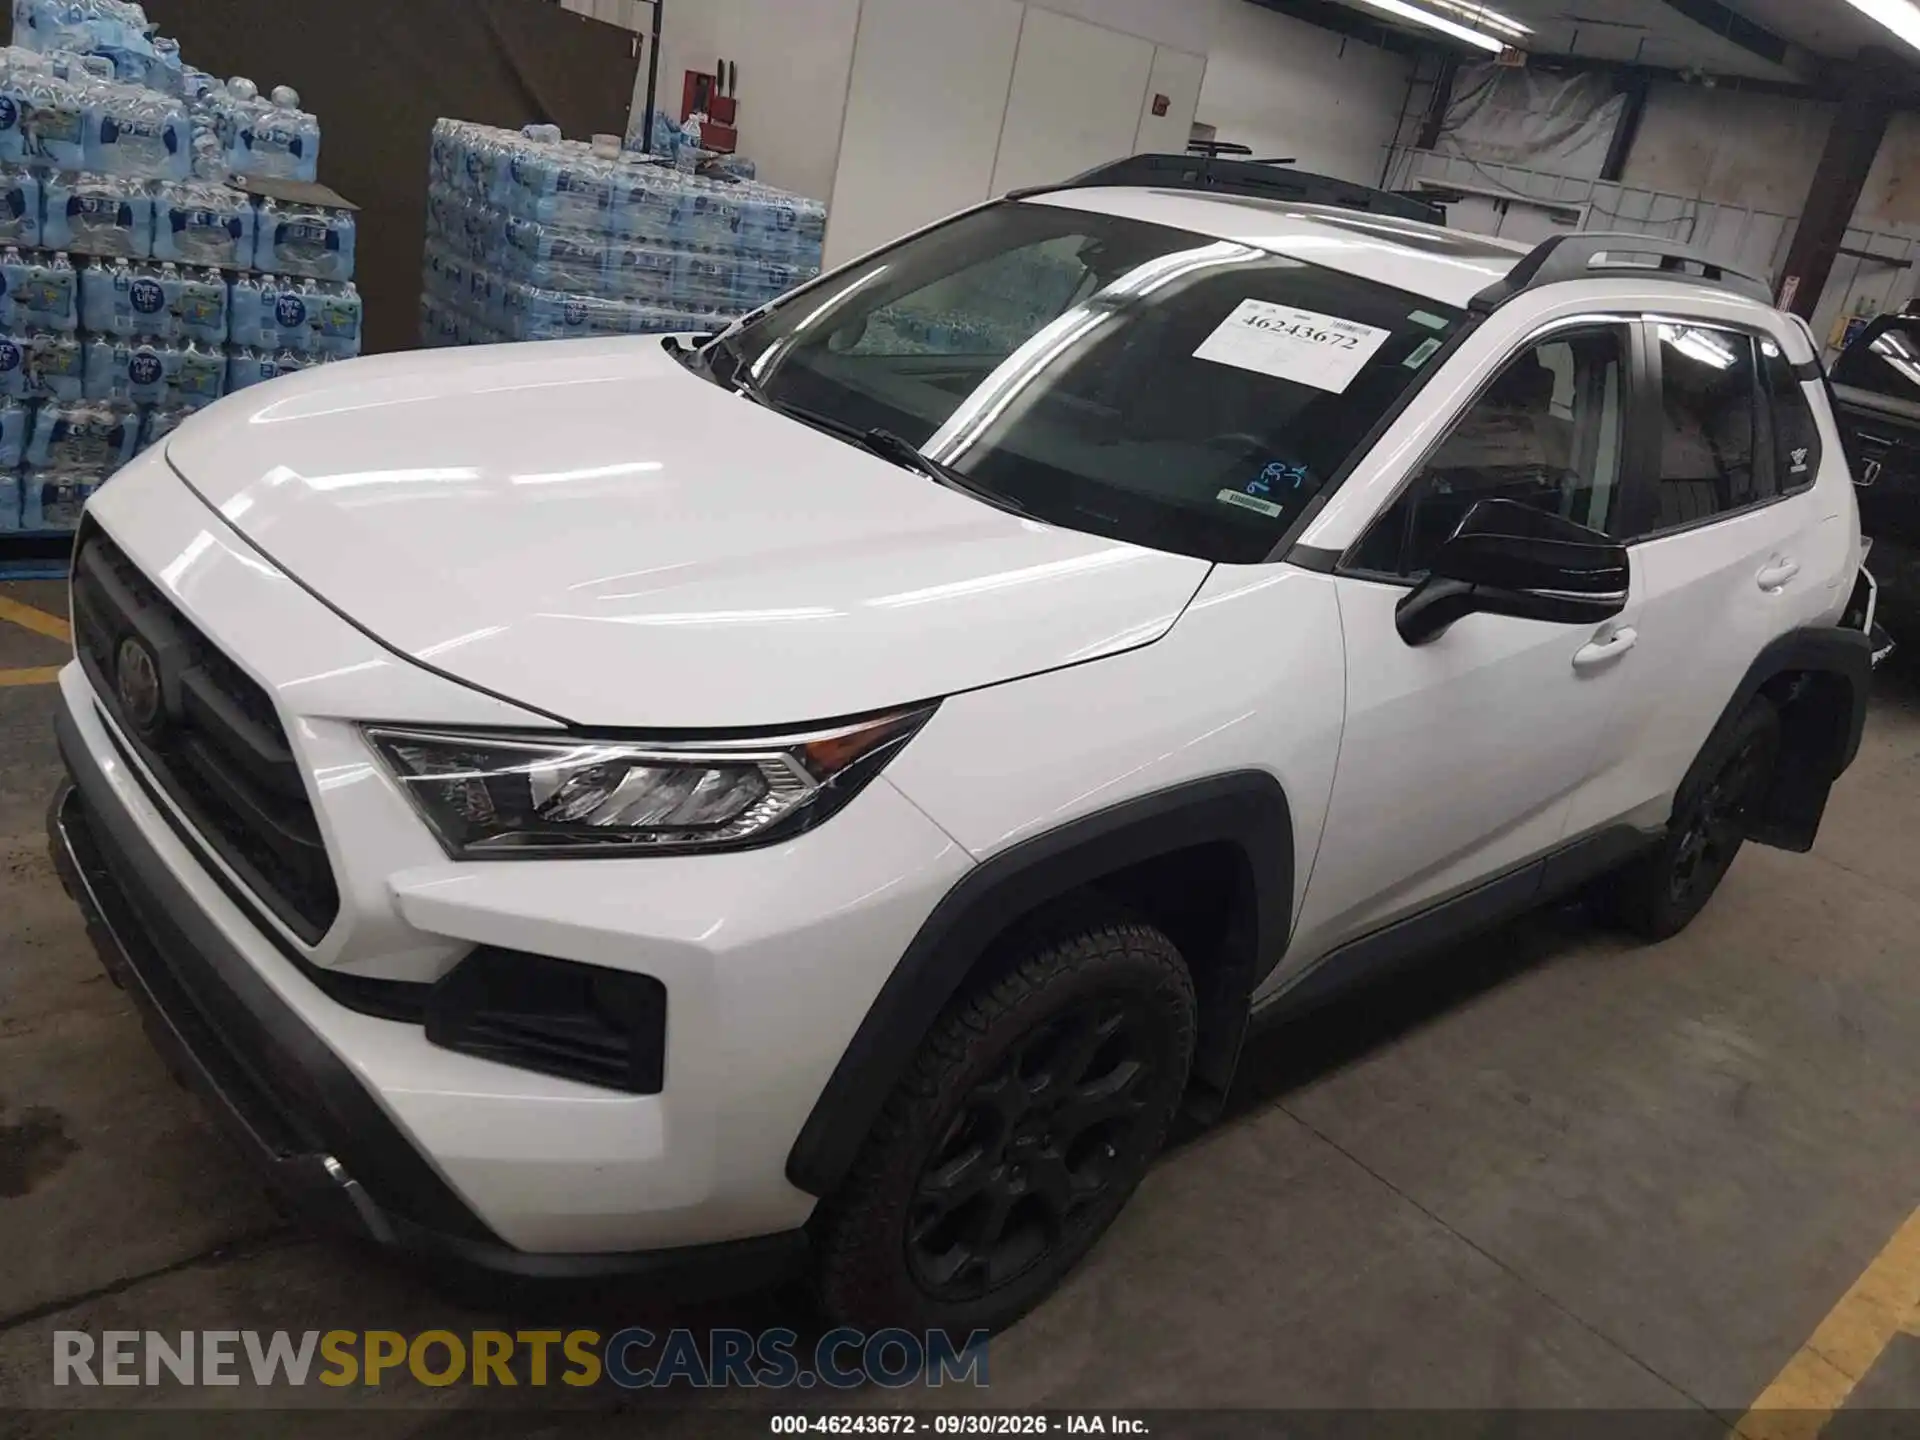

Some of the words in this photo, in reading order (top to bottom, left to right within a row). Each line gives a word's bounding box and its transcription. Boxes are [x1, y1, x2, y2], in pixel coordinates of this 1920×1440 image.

[133, 283, 159, 293] Pure
[279, 299, 300, 308] Pure
[1242, 315, 1358, 349] 46243672
